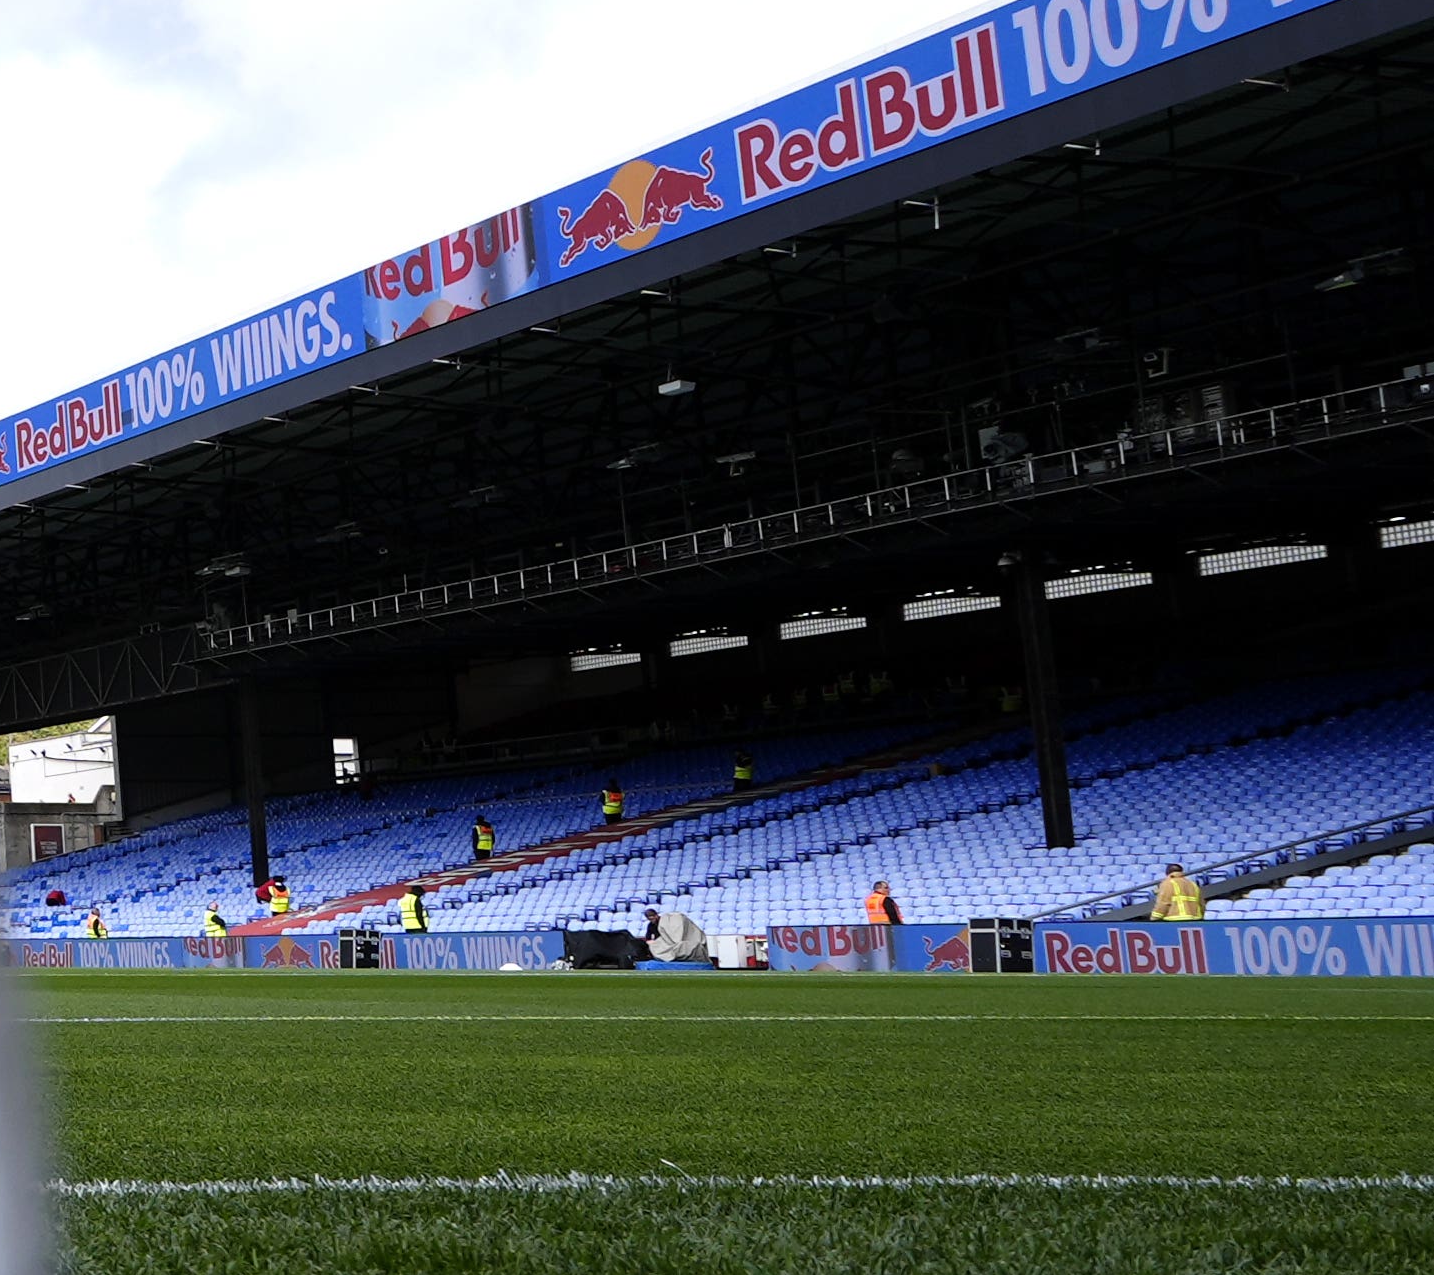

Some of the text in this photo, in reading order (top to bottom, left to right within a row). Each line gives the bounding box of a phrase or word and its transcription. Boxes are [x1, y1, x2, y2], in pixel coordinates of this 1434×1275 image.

[126, 347, 205, 428] 100%
[79, 941, 114, 968] 100%
[403, 936, 458, 970] 100%
[1224, 925, 1347, 975] 100%
